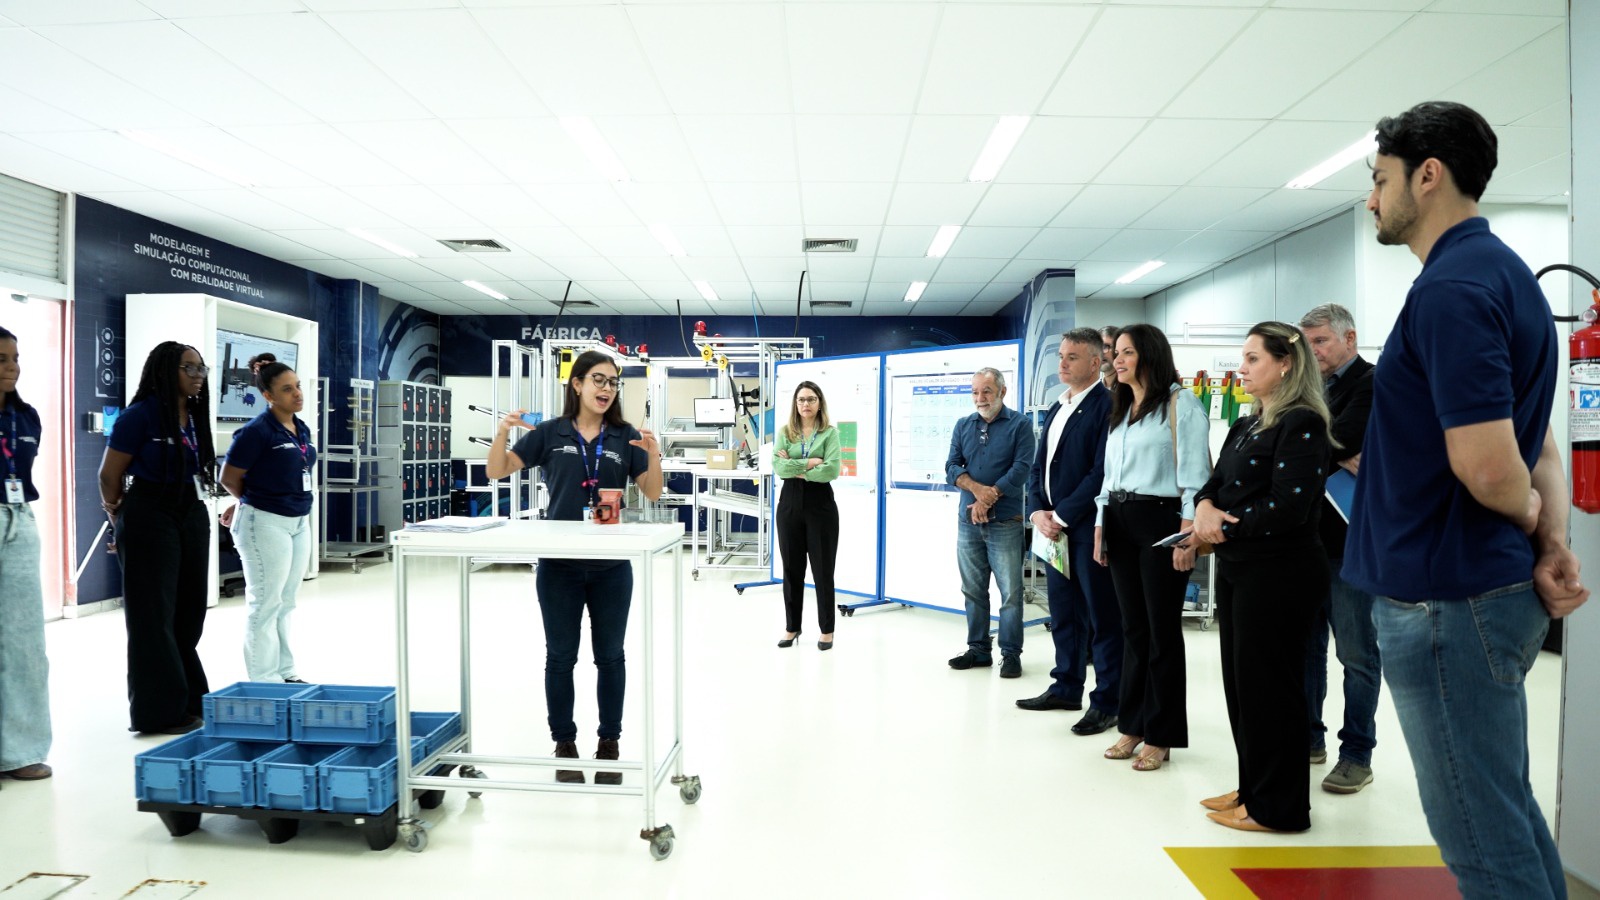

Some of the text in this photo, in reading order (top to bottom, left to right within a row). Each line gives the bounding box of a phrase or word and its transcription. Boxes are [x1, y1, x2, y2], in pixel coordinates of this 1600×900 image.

[150, 232, 210, 258] MODELAGEM E
[134, 243, 252, 283] SIMULAÇÃO COMPUTACIONAL
[170, 267, 265, 299] COM REALIDADE VIRTUAL
[521, 324, 603, 340] FÁBRICA
